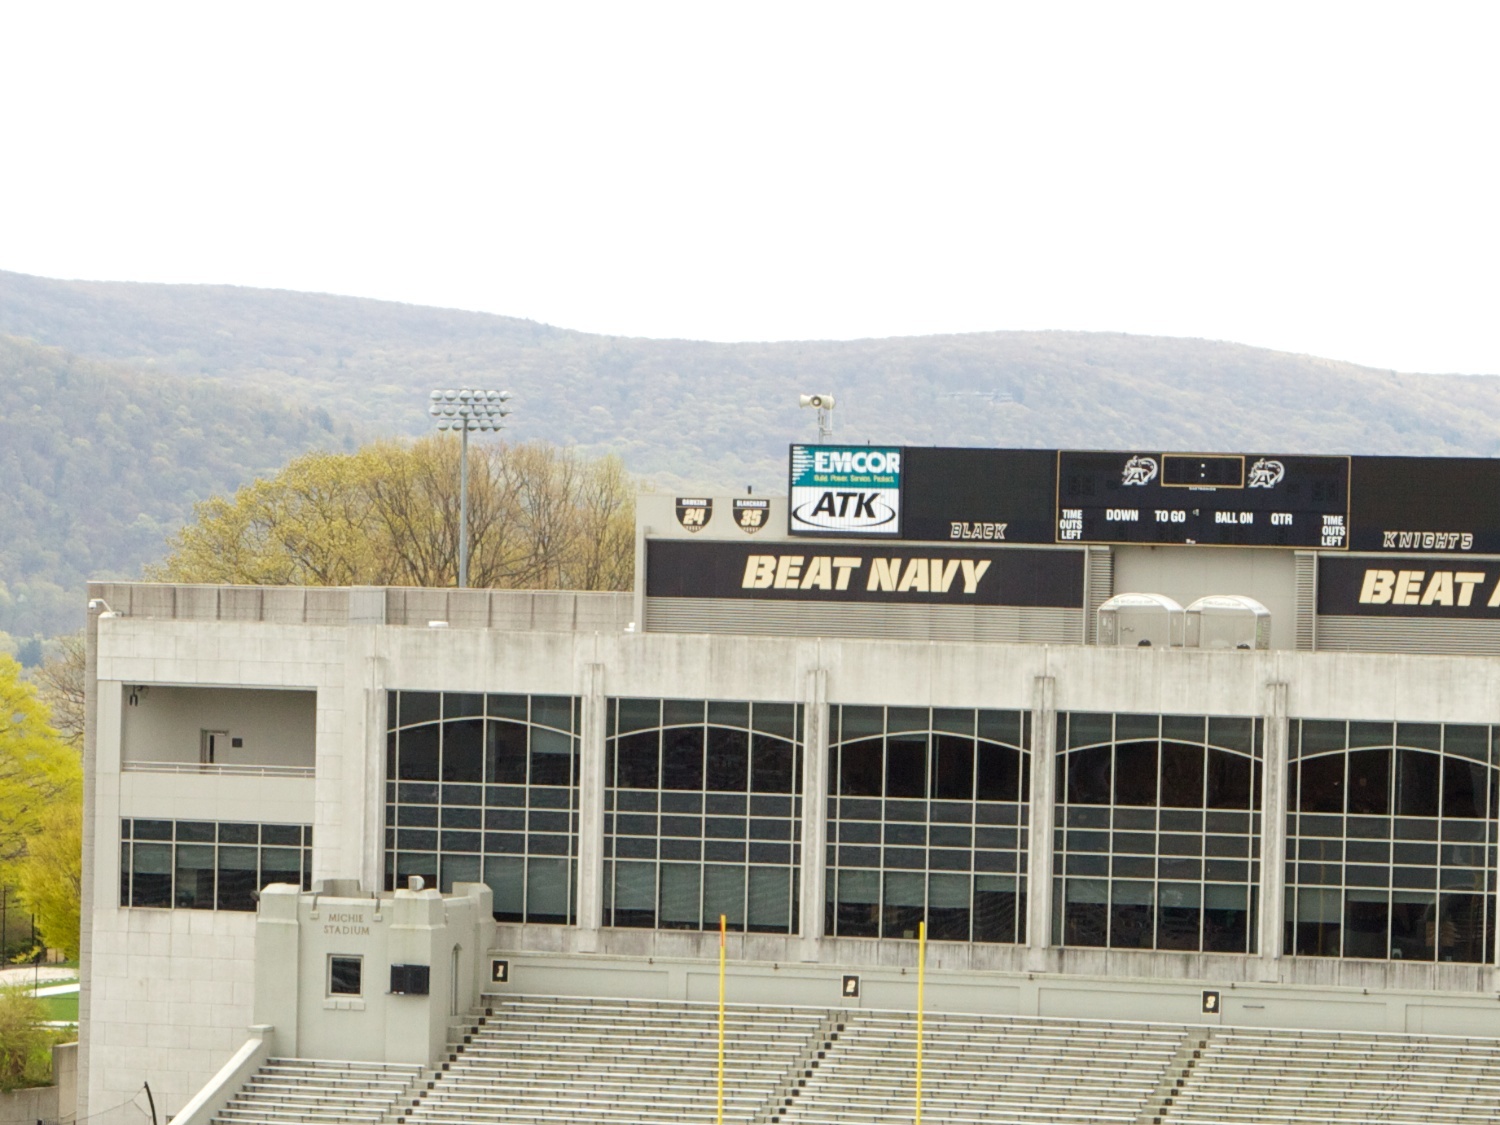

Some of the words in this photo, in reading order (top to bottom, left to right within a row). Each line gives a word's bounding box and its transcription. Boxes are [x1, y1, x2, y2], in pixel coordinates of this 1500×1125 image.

[814, 451, 900, 473] EMCOR
[811, 492, 880, 518] ATK
[683, 508, 705, 525] 24
[740, 509, 762, 526] 35
[1062, 509, 1082, 519] TIME
[1106, 509, 1139, 521] DOWN
[1155, 510, 1169, 522] TO
[1171, 511, 1186, 522] GO
[1215, 512, 1238, 524] BALL
[1240, 512, 1253, 524] ON
[1271, 513, 1293, 525] QTR
[1060, 520, 1082, 530] OUTS
[1322, 515, 1343, 526] TIME
[950, 522, 1007, 539] BLACK
[1061, 530, 1082, 540] LEFT
[1322, 526, 1346, 536] OUTS
[1321, 536, 1342, 547] LEFT
[1383, 531, 1473, 550] KNIGHTS
[742, 555, 861, 590] BEAT
[867, 558, 992, 594] NAVY
[1358, 569, 1485, 607] BEAT
[328, 914, 363, 923] MICHIE
[324, 925, 370, 935] STADIUM
[496, 965, 504, 977] 1
[846, 980, 855, 992] 2
[1206, 996, 1215, 1008] 3
